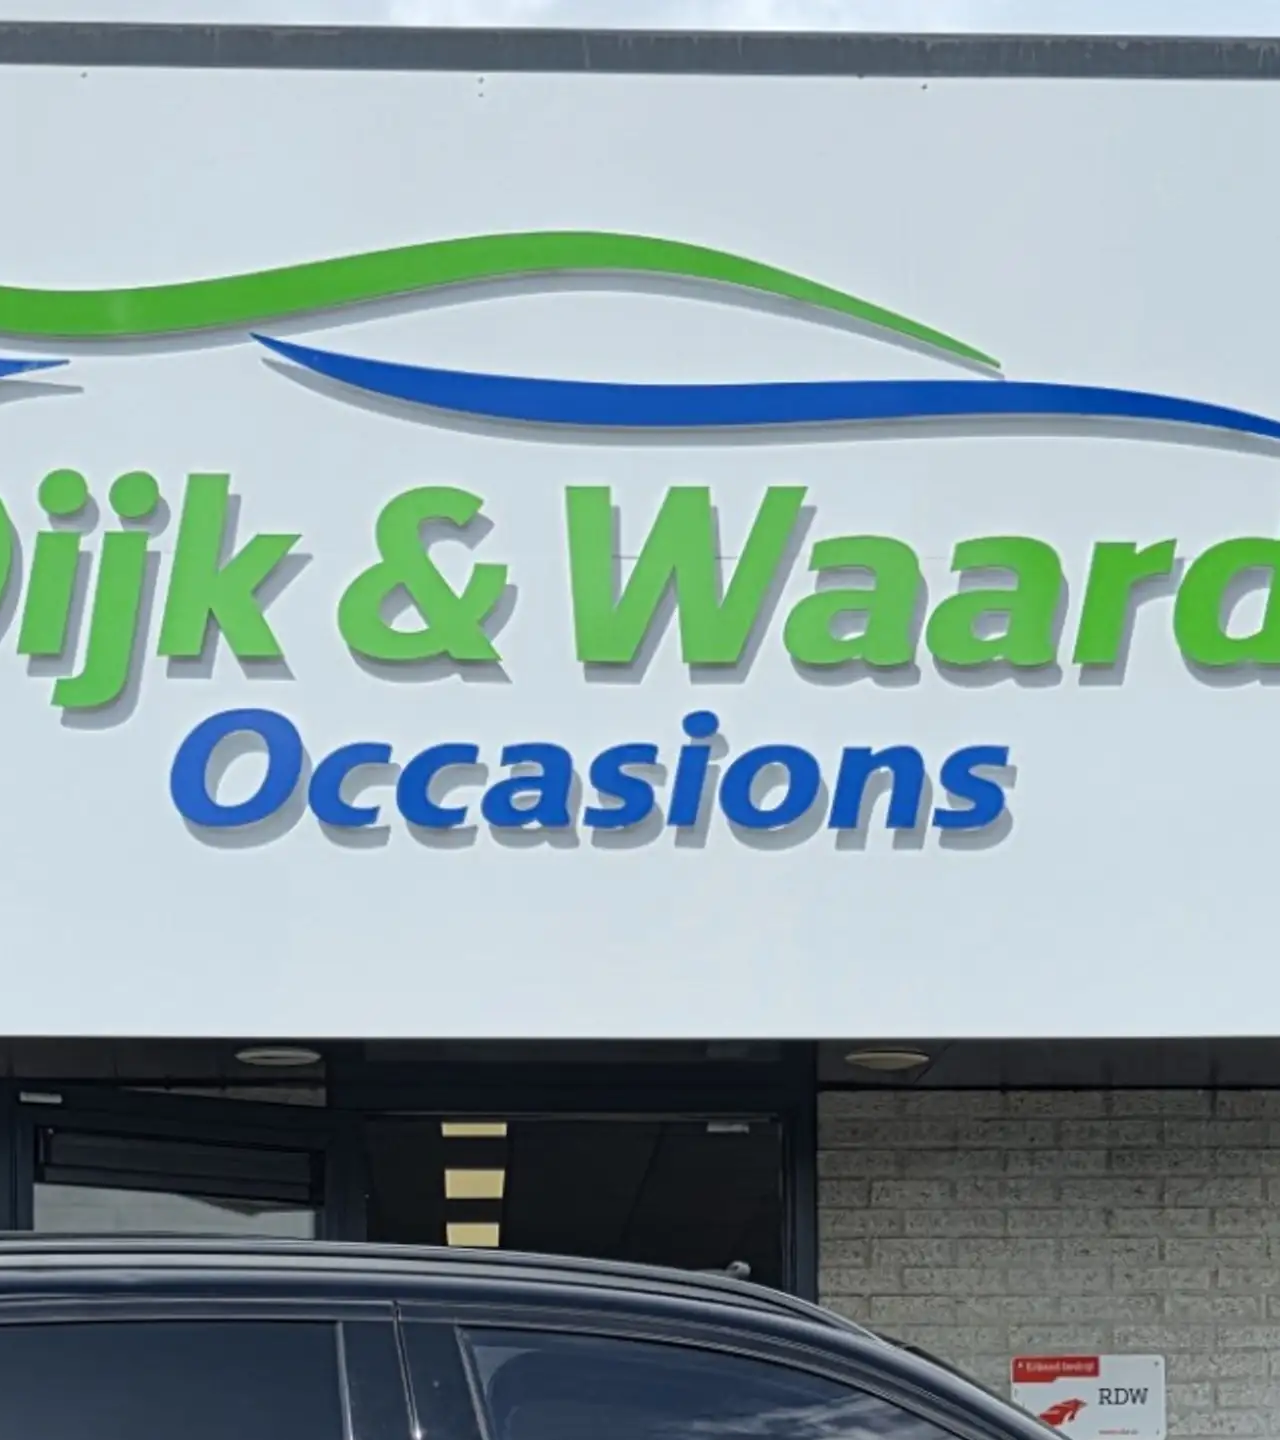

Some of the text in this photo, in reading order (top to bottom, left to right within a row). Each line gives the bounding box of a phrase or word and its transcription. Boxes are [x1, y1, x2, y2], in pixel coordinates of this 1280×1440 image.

[338, 486, 508, 662] &
[170, 708, 1010, 829] Occasions
[1098, 1387, 1149, 1405] RDW
